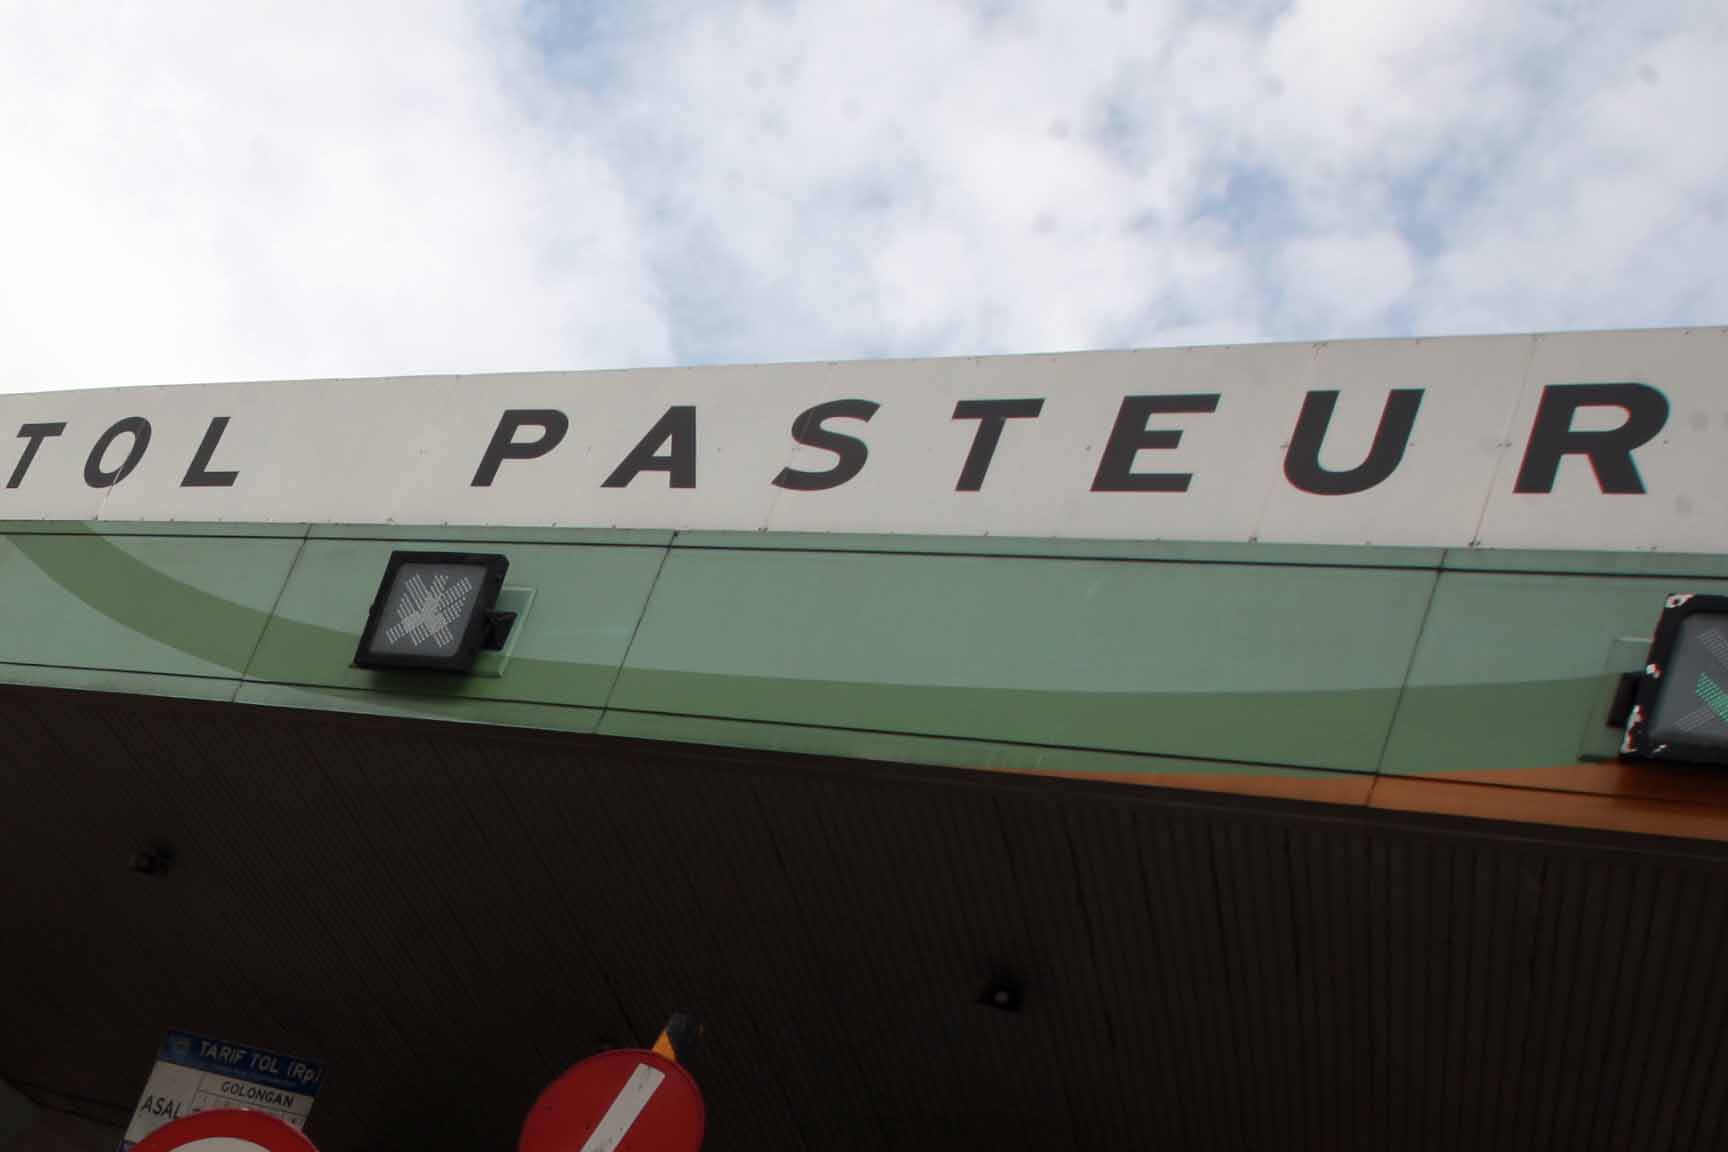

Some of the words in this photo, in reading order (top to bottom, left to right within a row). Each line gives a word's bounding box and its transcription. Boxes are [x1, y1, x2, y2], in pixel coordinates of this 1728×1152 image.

[4, 416, 240, 489] TOL
[469, 382, 1670, 496] PASTEUR
[199, 1040, 247, 1065] TARIF
[249, 1053, 280, 1073] TOL
[221, 1081, 294, 1107] GOLONGAN
